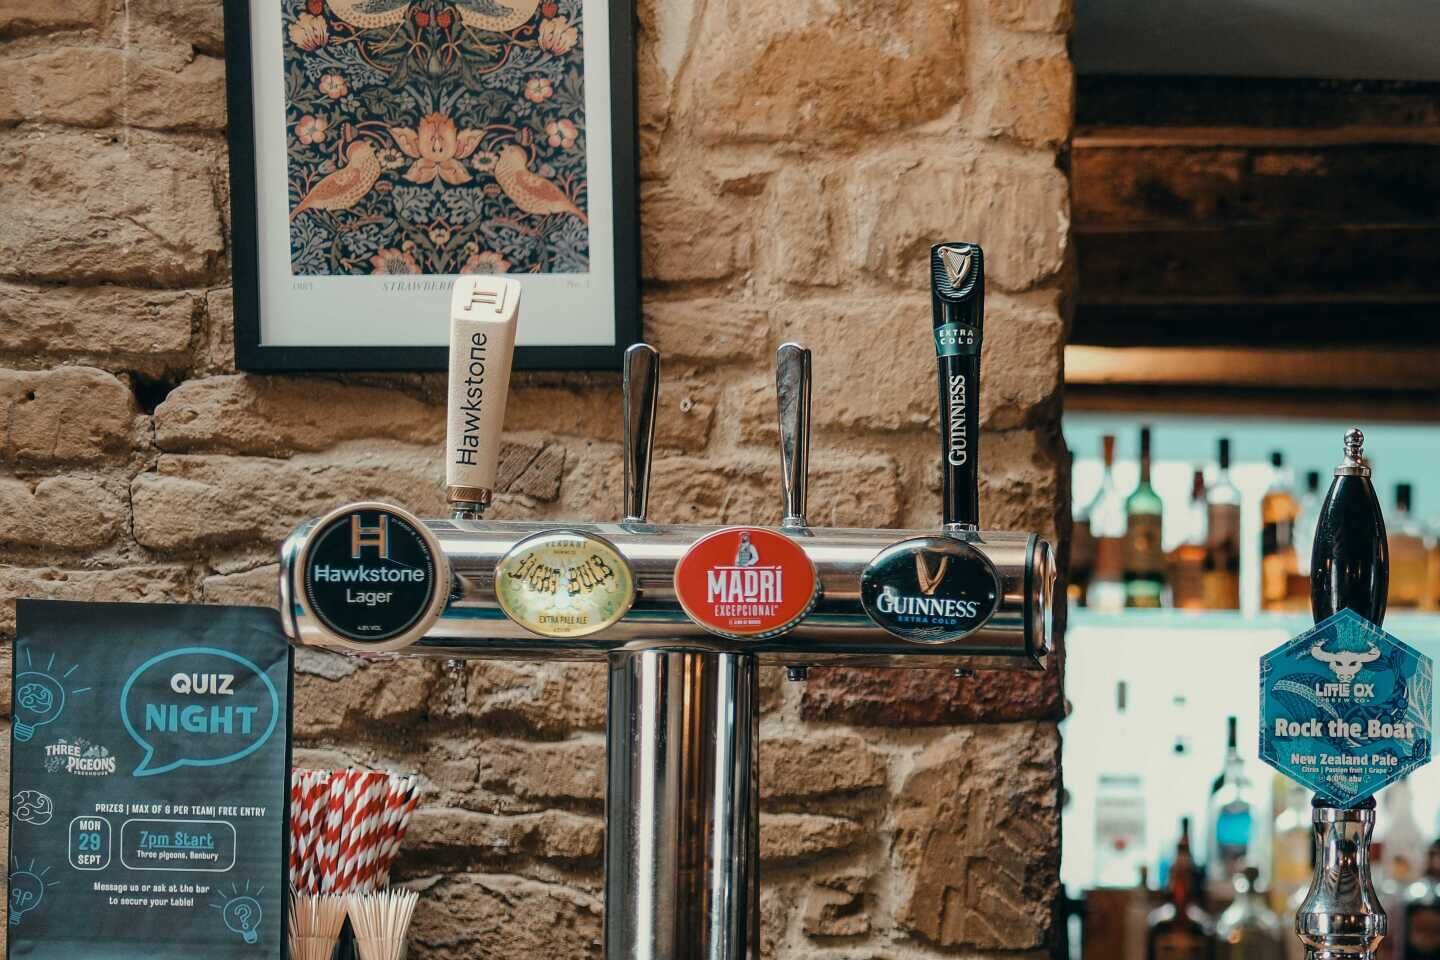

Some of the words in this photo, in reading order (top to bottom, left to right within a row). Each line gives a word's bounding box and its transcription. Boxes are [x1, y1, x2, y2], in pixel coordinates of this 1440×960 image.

[384, 281, 455, 291] STRAWBERR
[939, 328, 974, 337] EXTRA
[940, 337, 974, 345] COLD
[455, 331, 488, 467] Hawkstone
[948, 374, 968, 467] GUINNESS
[314, 564, 425, 582] Hawkstone
[346, 588, 392, 606] Lager
[714, 604, 777, 617] EXCEPCIONAL
[876, 592, 978, 618] GUINNESS
[897, 615, 928, 623] EXTRA
[931, 617, 957, 625] COLD
[170, 672, 235, 695] QUIZ
[1315, 682, 1350, 697] LITTLE
[1353, 683, 1375, 698] OX
[145, 703, 258, 735] NIGHT
[1275, 718, 1323, 737] Rock
[1327, 718, 1362, 738] the
[1367, 719, 1415, 739] Boat
[44, 744, 81, 757] THREE
[65, 756, 116, 773] PIGEONS
[1290, 753, 1317, 765] New
[1319, 753, 1369, 766] Zealand
[1371, 754, 1398, 766] Pale
[95, 803, 124, 813] PRIZES
[132, 804, 149, 814] MAX
[151, 804, 162, 814] OF
[173, 805, 189, 815] PER
[218, 806, 238, 816] FREE
[240, 806, 266, 817] ENTRY
[80, 820, 101, 831] MON
[79, 832, 101, 851] 29
[139, 830, 169, 849] 7pm
[175, 831, 214, 848] Start
[78, 854, 102, 865] SEPT
[137, 850, 158, 858] Three
[189, 850, 219, 862] Banbury
[93, 881, 128, 893] Message
[130, 884, 139, 892] us
[141, 884, 150, 892] or
[152, 883, 166, 892] ask
[168, 884, 177, 893] at
[179, 884, 194, 893] the
[196, 884, 210, 894] bar
[109, 896, 118, 905] to
[150, 898, 169, 908] your
[170, 898, 194, 907] table!
